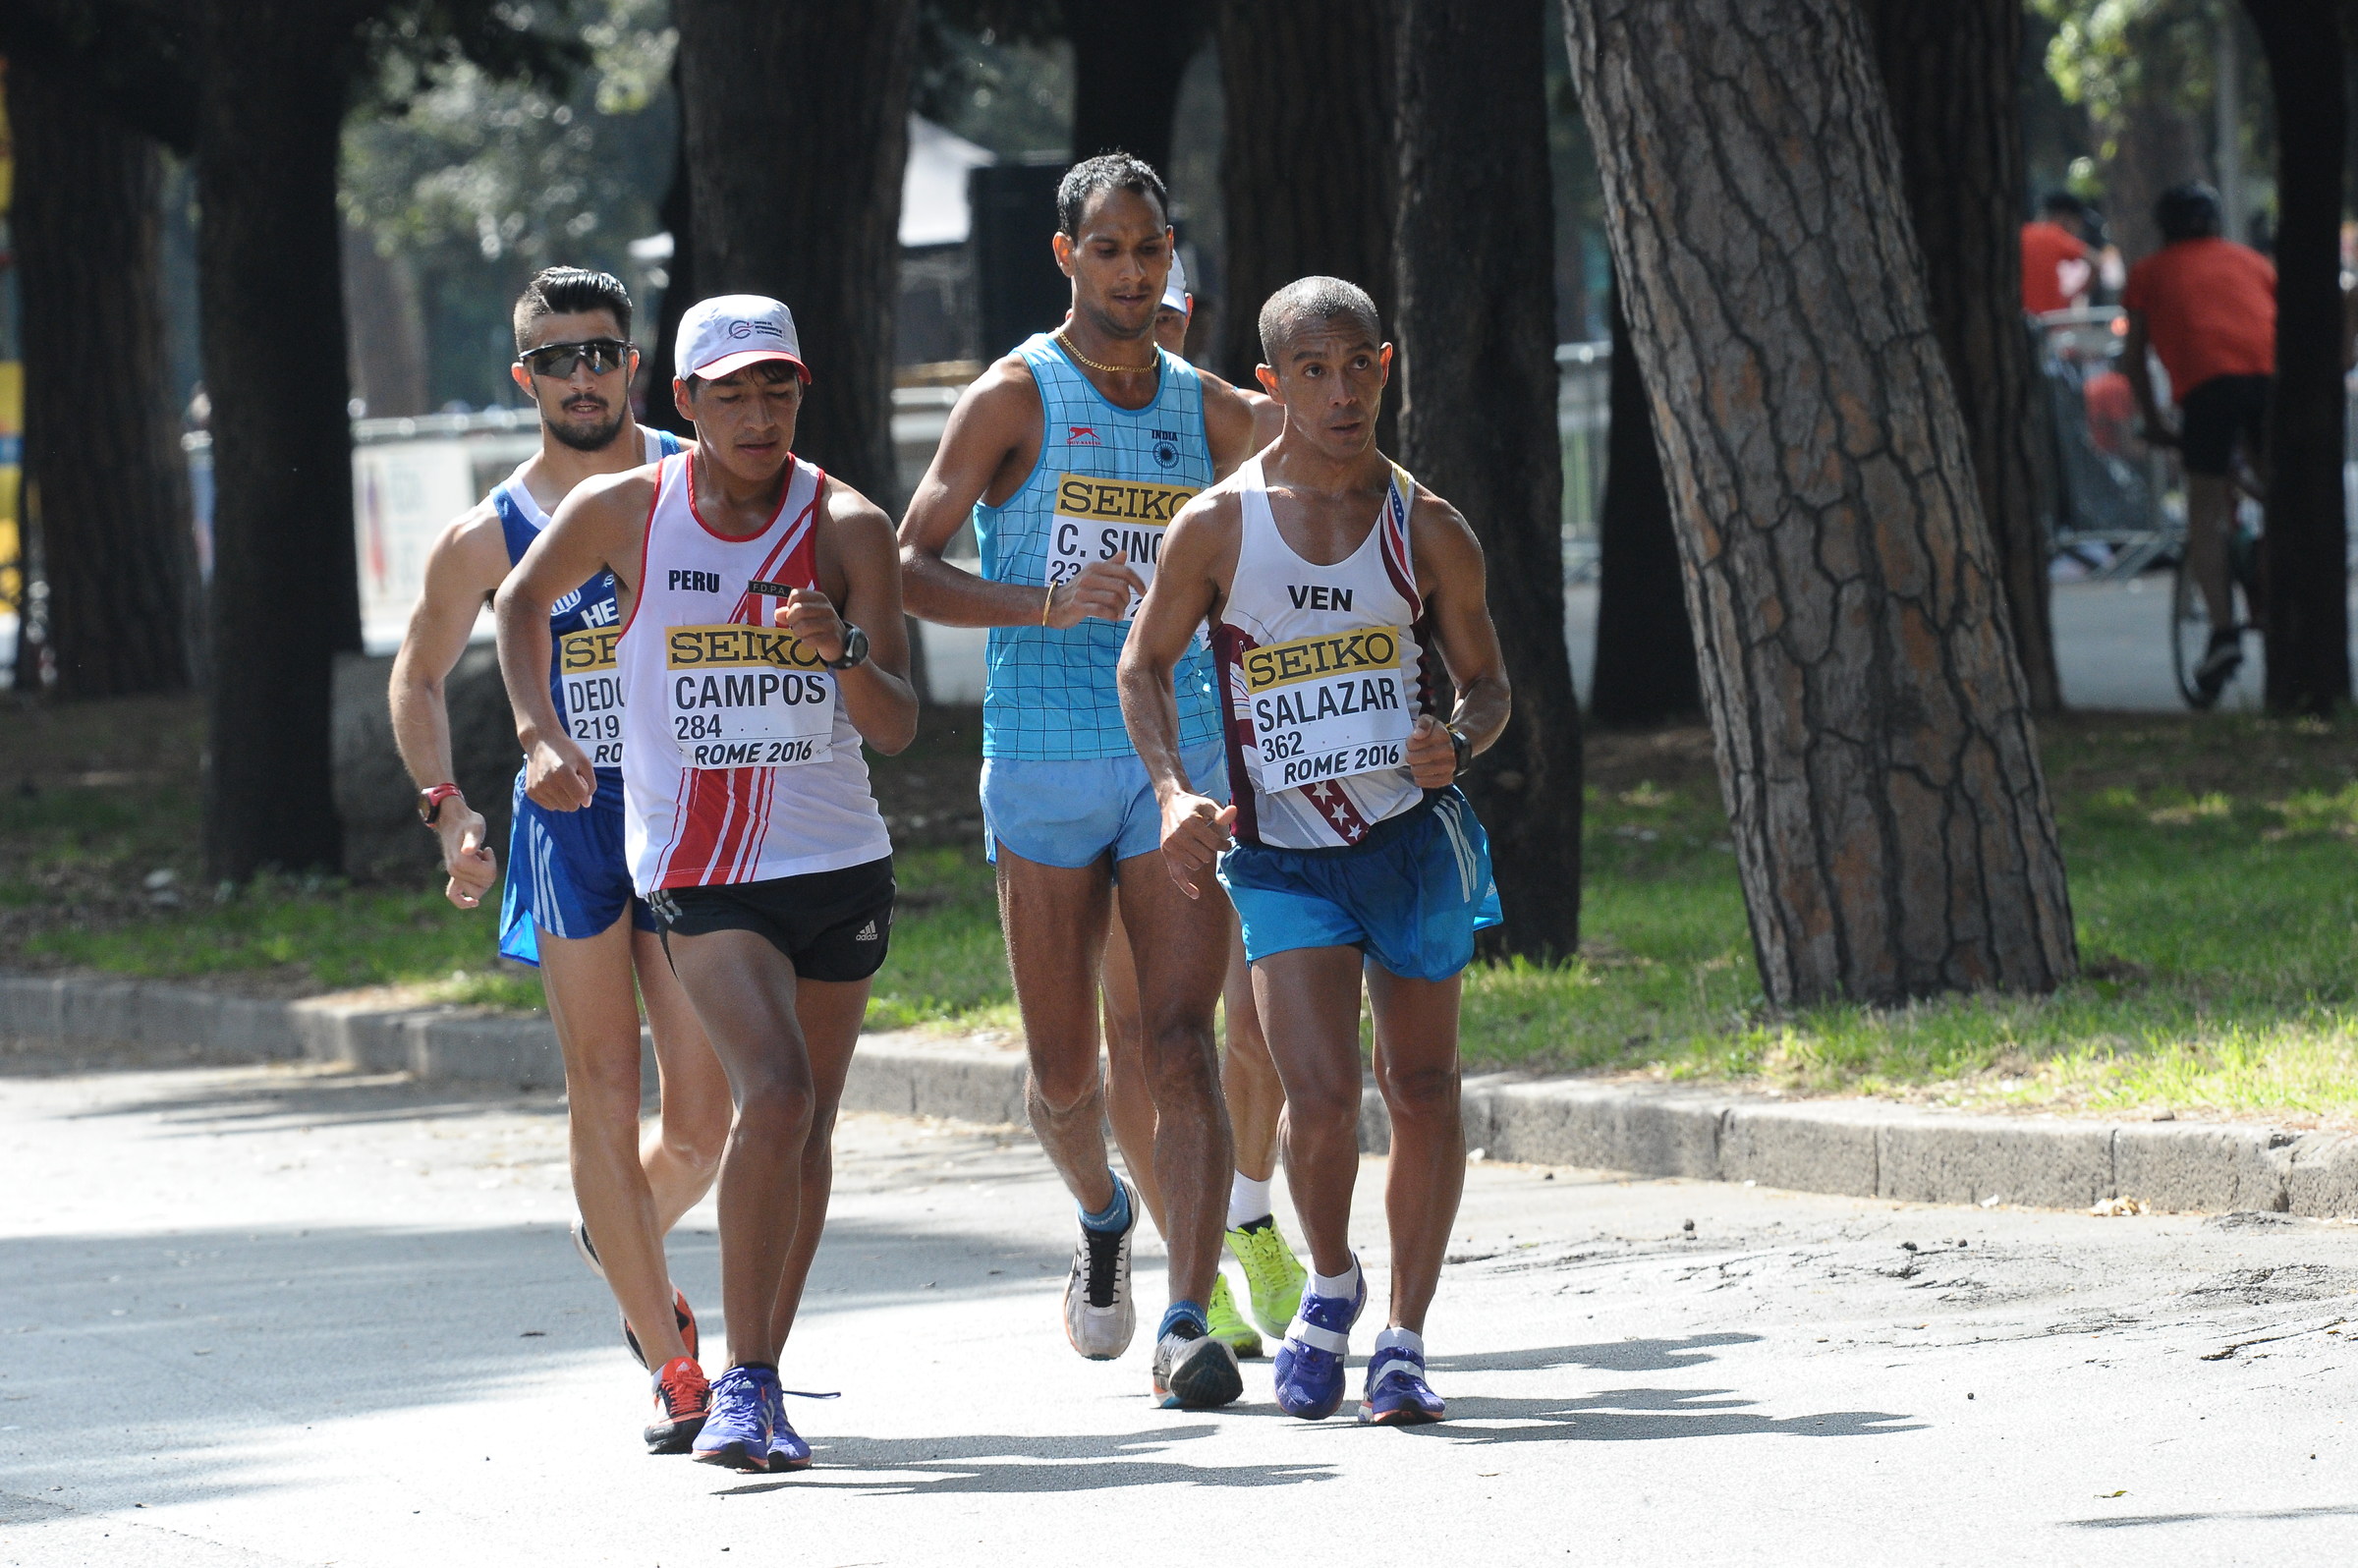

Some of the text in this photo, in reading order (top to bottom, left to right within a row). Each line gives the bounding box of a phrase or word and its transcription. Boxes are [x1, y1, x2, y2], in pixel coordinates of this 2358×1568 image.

[1151, 429, 1178, 442] INDIA
[1057, 524, 1087, 558] C.
[668, 569, 720, 593] PERU
[581, 597, 620, 629] HE
[1287, 585, 1353, 612] VEN
[670, 631, 820, 667] SEIKO
[1248, 632, 1394, 688] SEIKO
[569, 676, 625, 714] DED
[675, 674, 826, 710] CAMPOS
[1256, 677, 1399, 733] SALAZAR
[575, 714, 620, 740] 219
[674, 713, 722, 741] 284
[694, 740, 813, 766] ROME 2016
[1262, 731, 1305, 763] 362
[1283, 744, 1399, 785] ROME 2016
